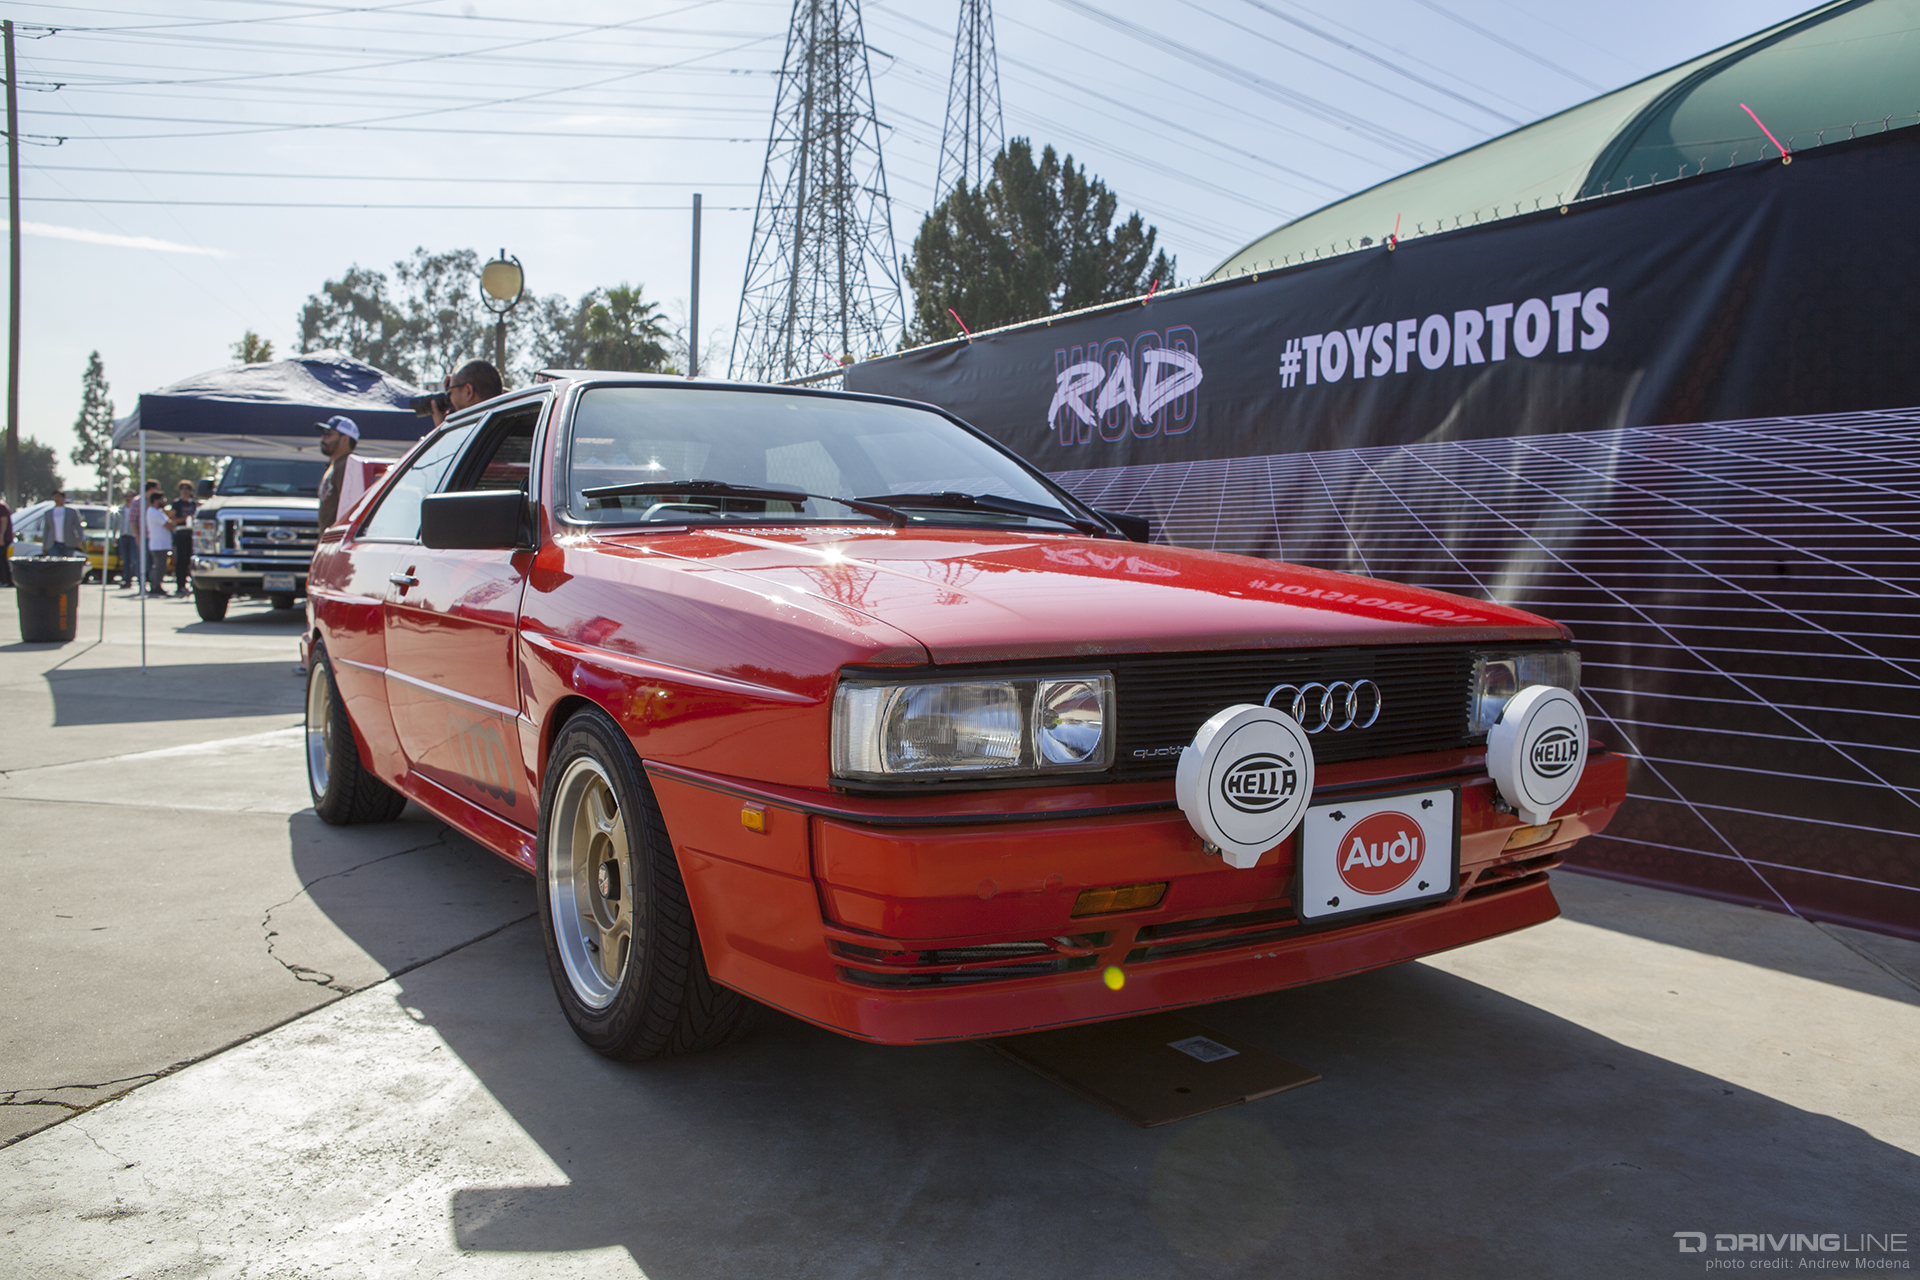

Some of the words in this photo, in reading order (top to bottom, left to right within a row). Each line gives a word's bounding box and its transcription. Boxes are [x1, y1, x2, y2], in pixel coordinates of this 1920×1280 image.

[1279, 287, 1610, 388] #TOYSFORTOTS
[1047, 347, 1204, 430] RAD
[1054, 324, 1199, 446] WOOD
[1133, 745, 1184, 759] quatt
[1534, 738, 1579, 762] HELLA
[1228, 769, 1297, 796] HELLA
[1342, 830, 1418, 872] Audi
[615, 891, 647, 1033] KUMHO
